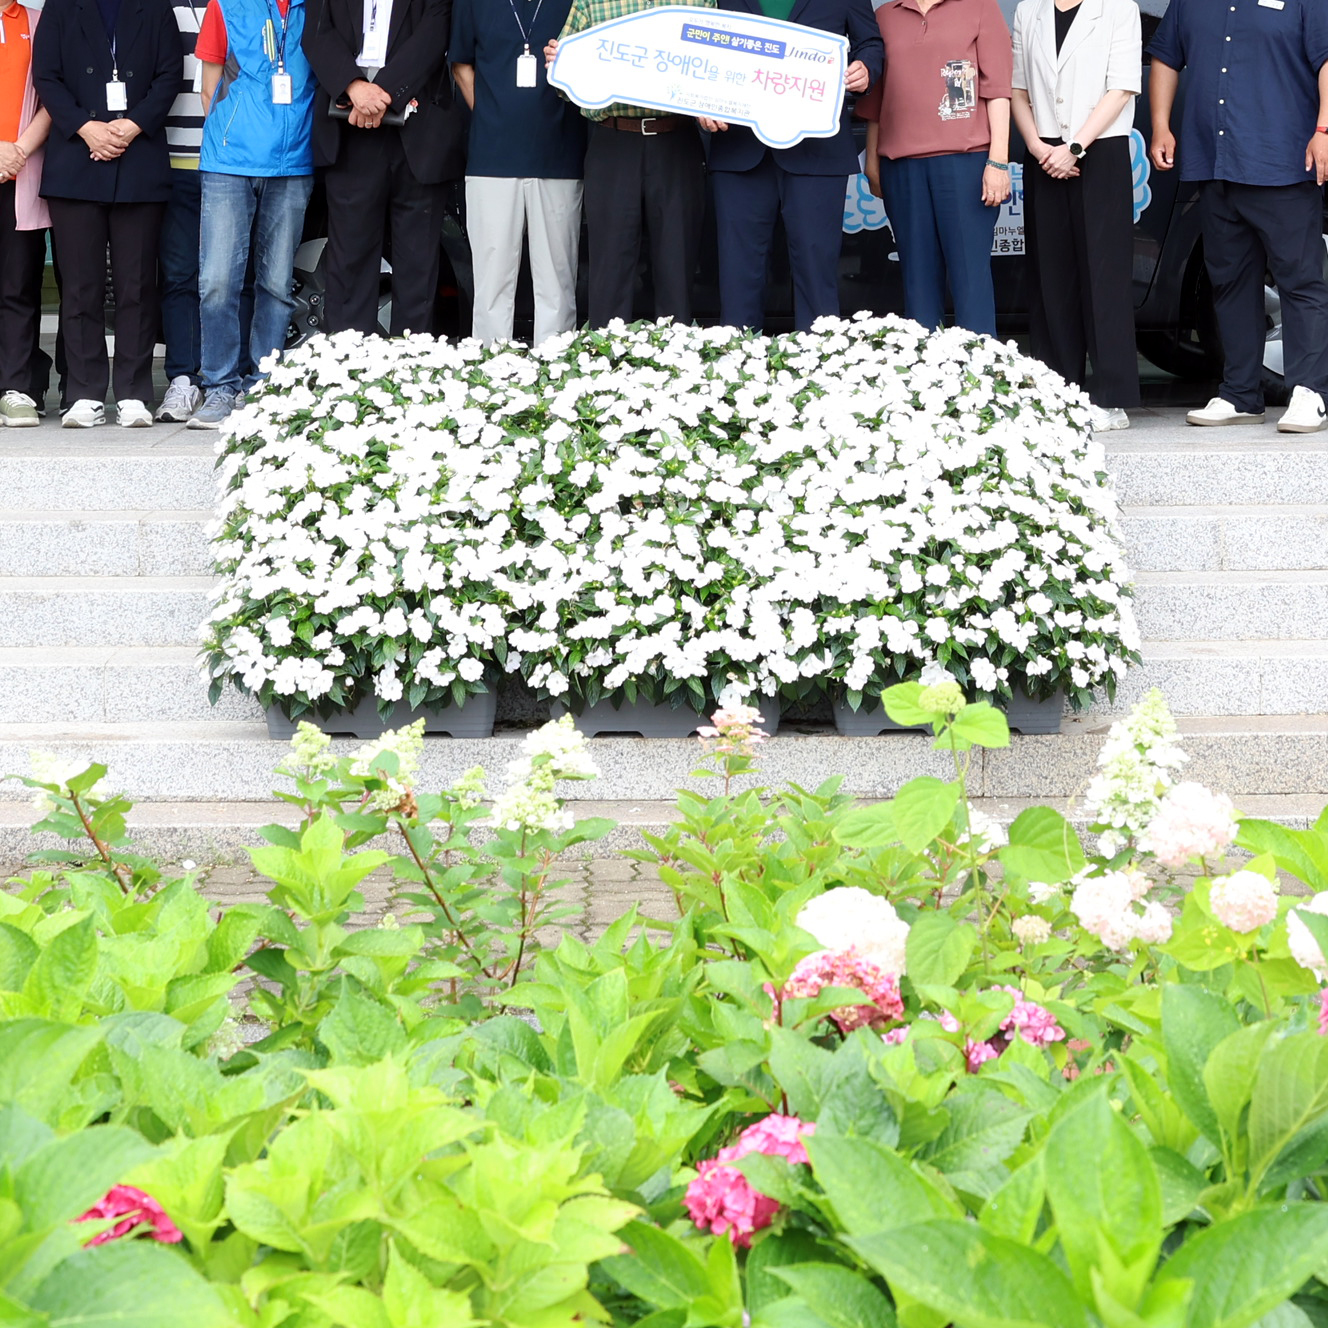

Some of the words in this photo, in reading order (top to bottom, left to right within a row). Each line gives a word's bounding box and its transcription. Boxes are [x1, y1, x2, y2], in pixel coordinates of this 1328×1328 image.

[686, 28, 711, 42] 군민이
[730, 36, 762, 52] 살기좋은
[764, 43, 780, 54] 진도
[596, 38, 649, 69] 진도군
[653, 49, 720, 82] 장애인을
[723, 70, 747, 87] 위한
[751, 68, 827, 103] 차량지원
